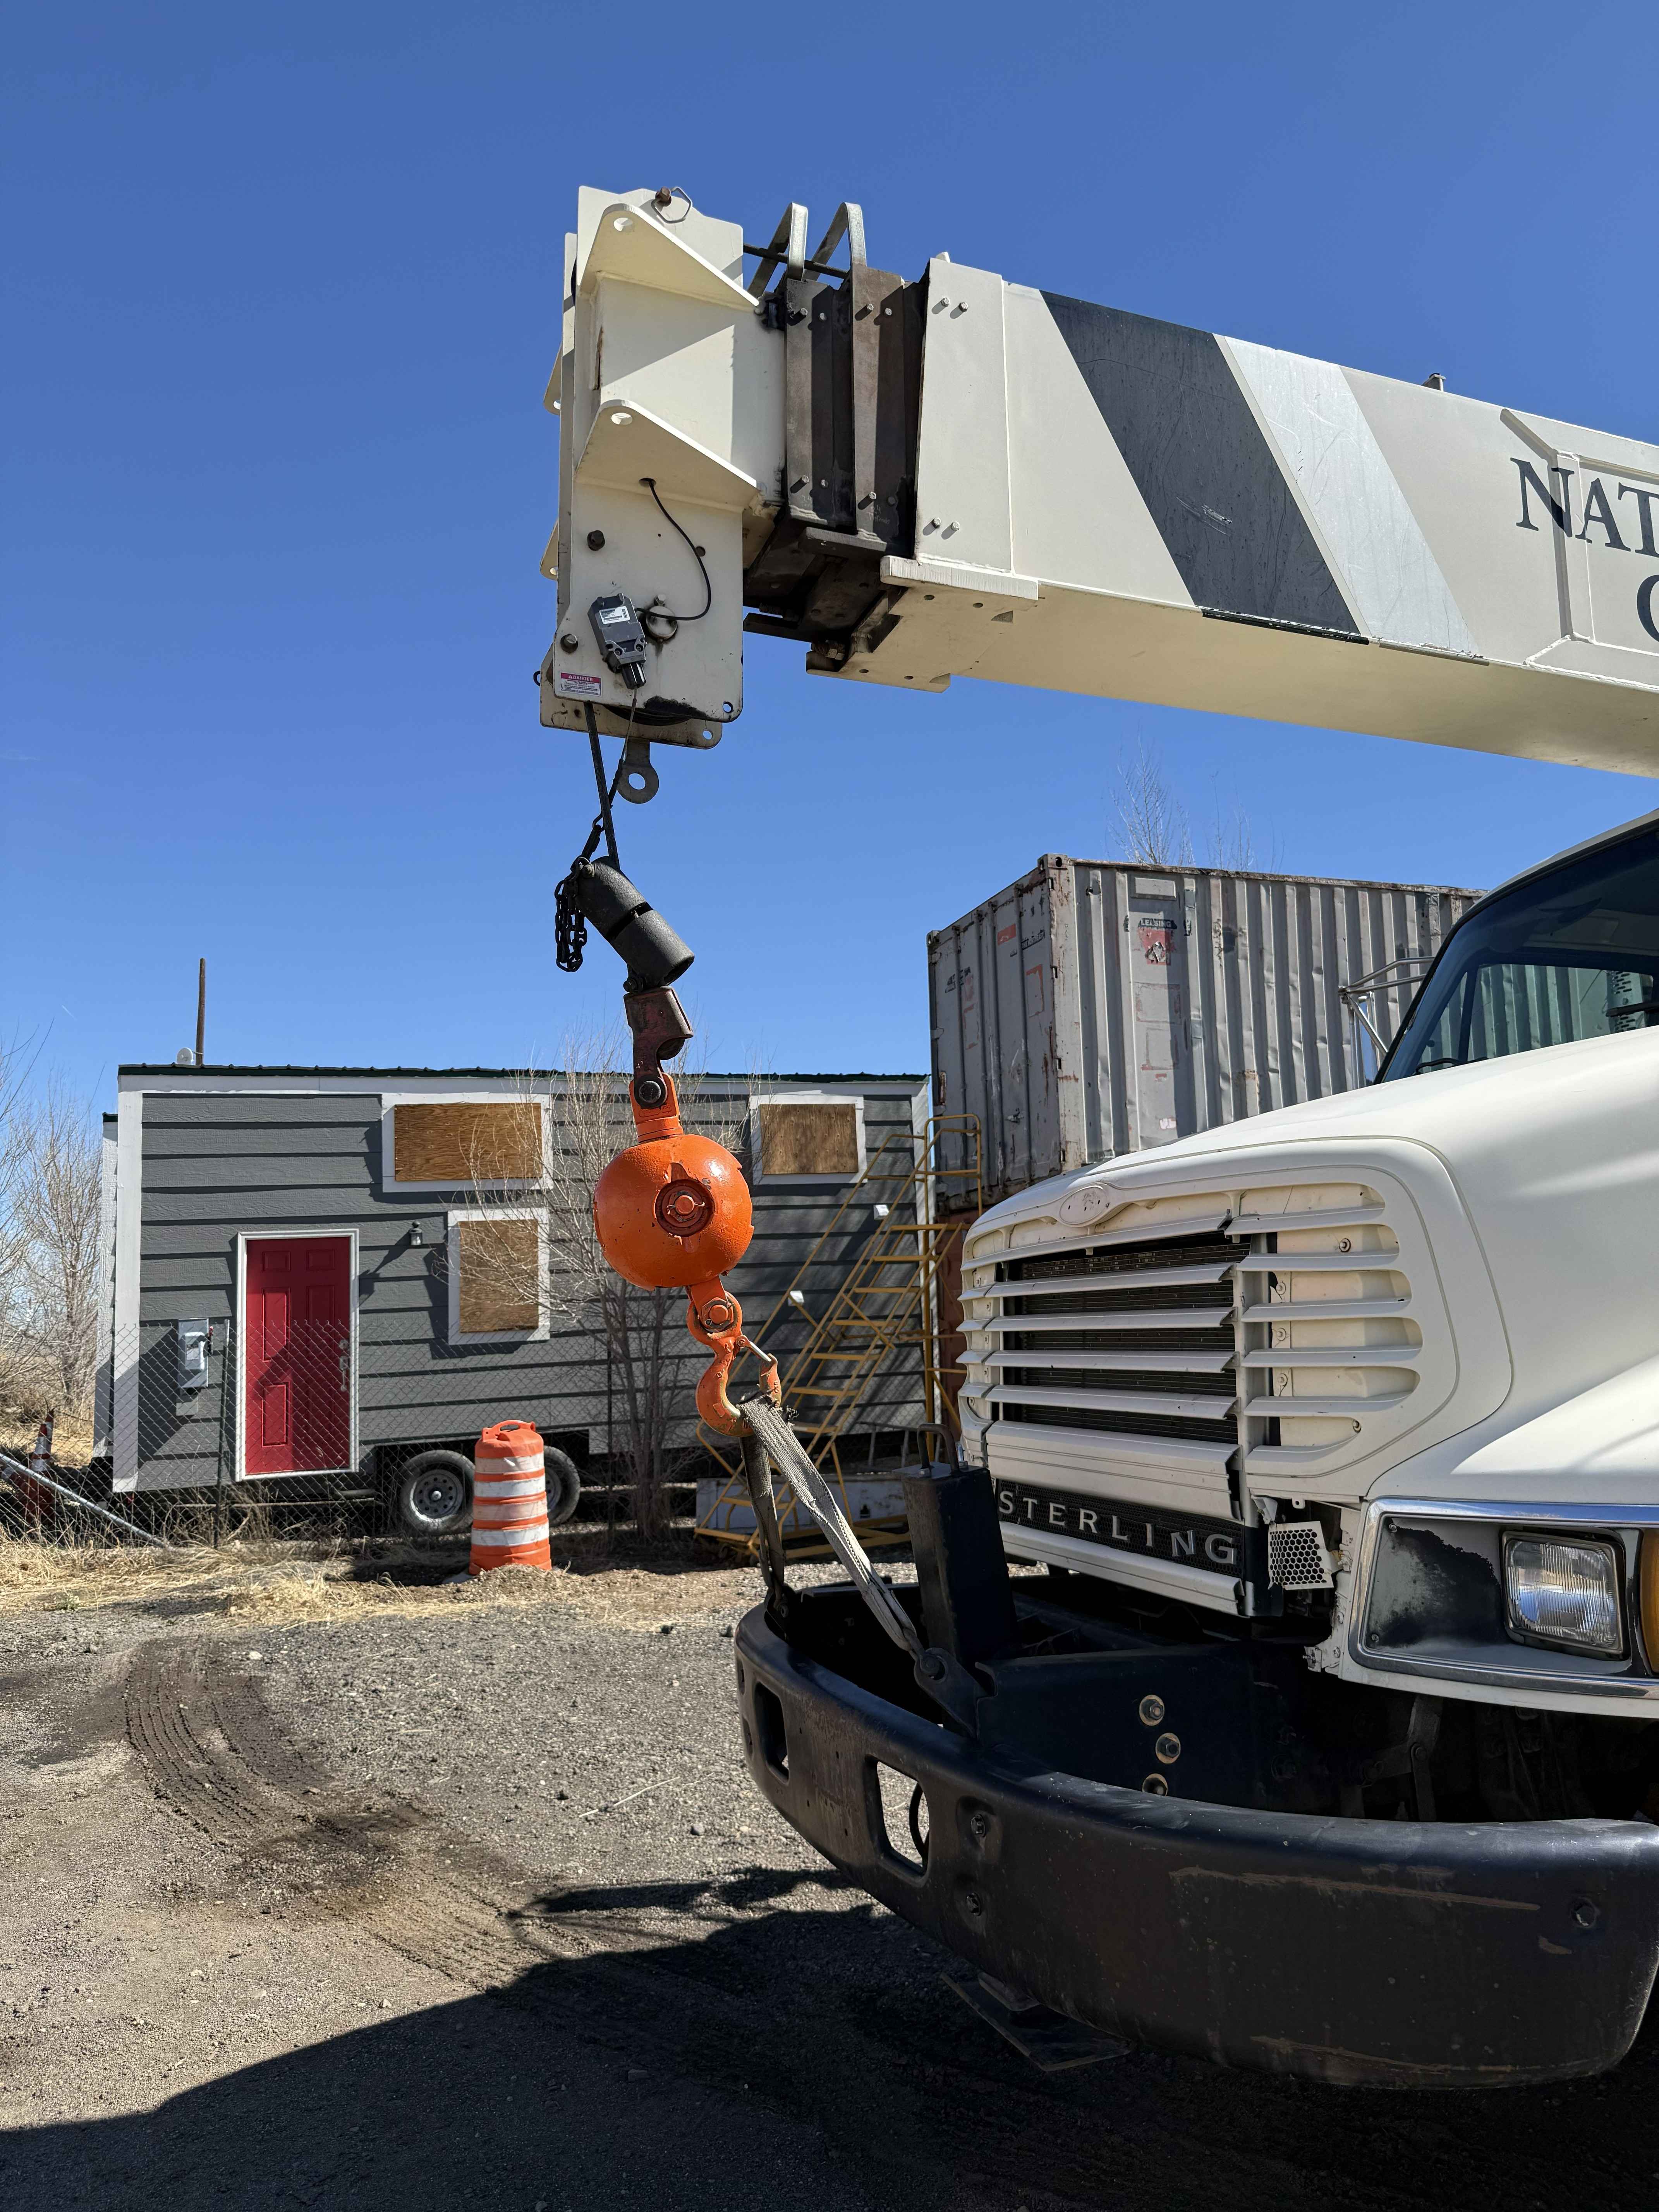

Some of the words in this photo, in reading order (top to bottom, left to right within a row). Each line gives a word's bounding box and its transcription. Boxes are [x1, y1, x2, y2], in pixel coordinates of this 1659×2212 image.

[1510, 457, 1659, 558] NAT
[1141, 918, 1171, 928] LEASING
[999, 1491, 1237, 1565] STERLING
